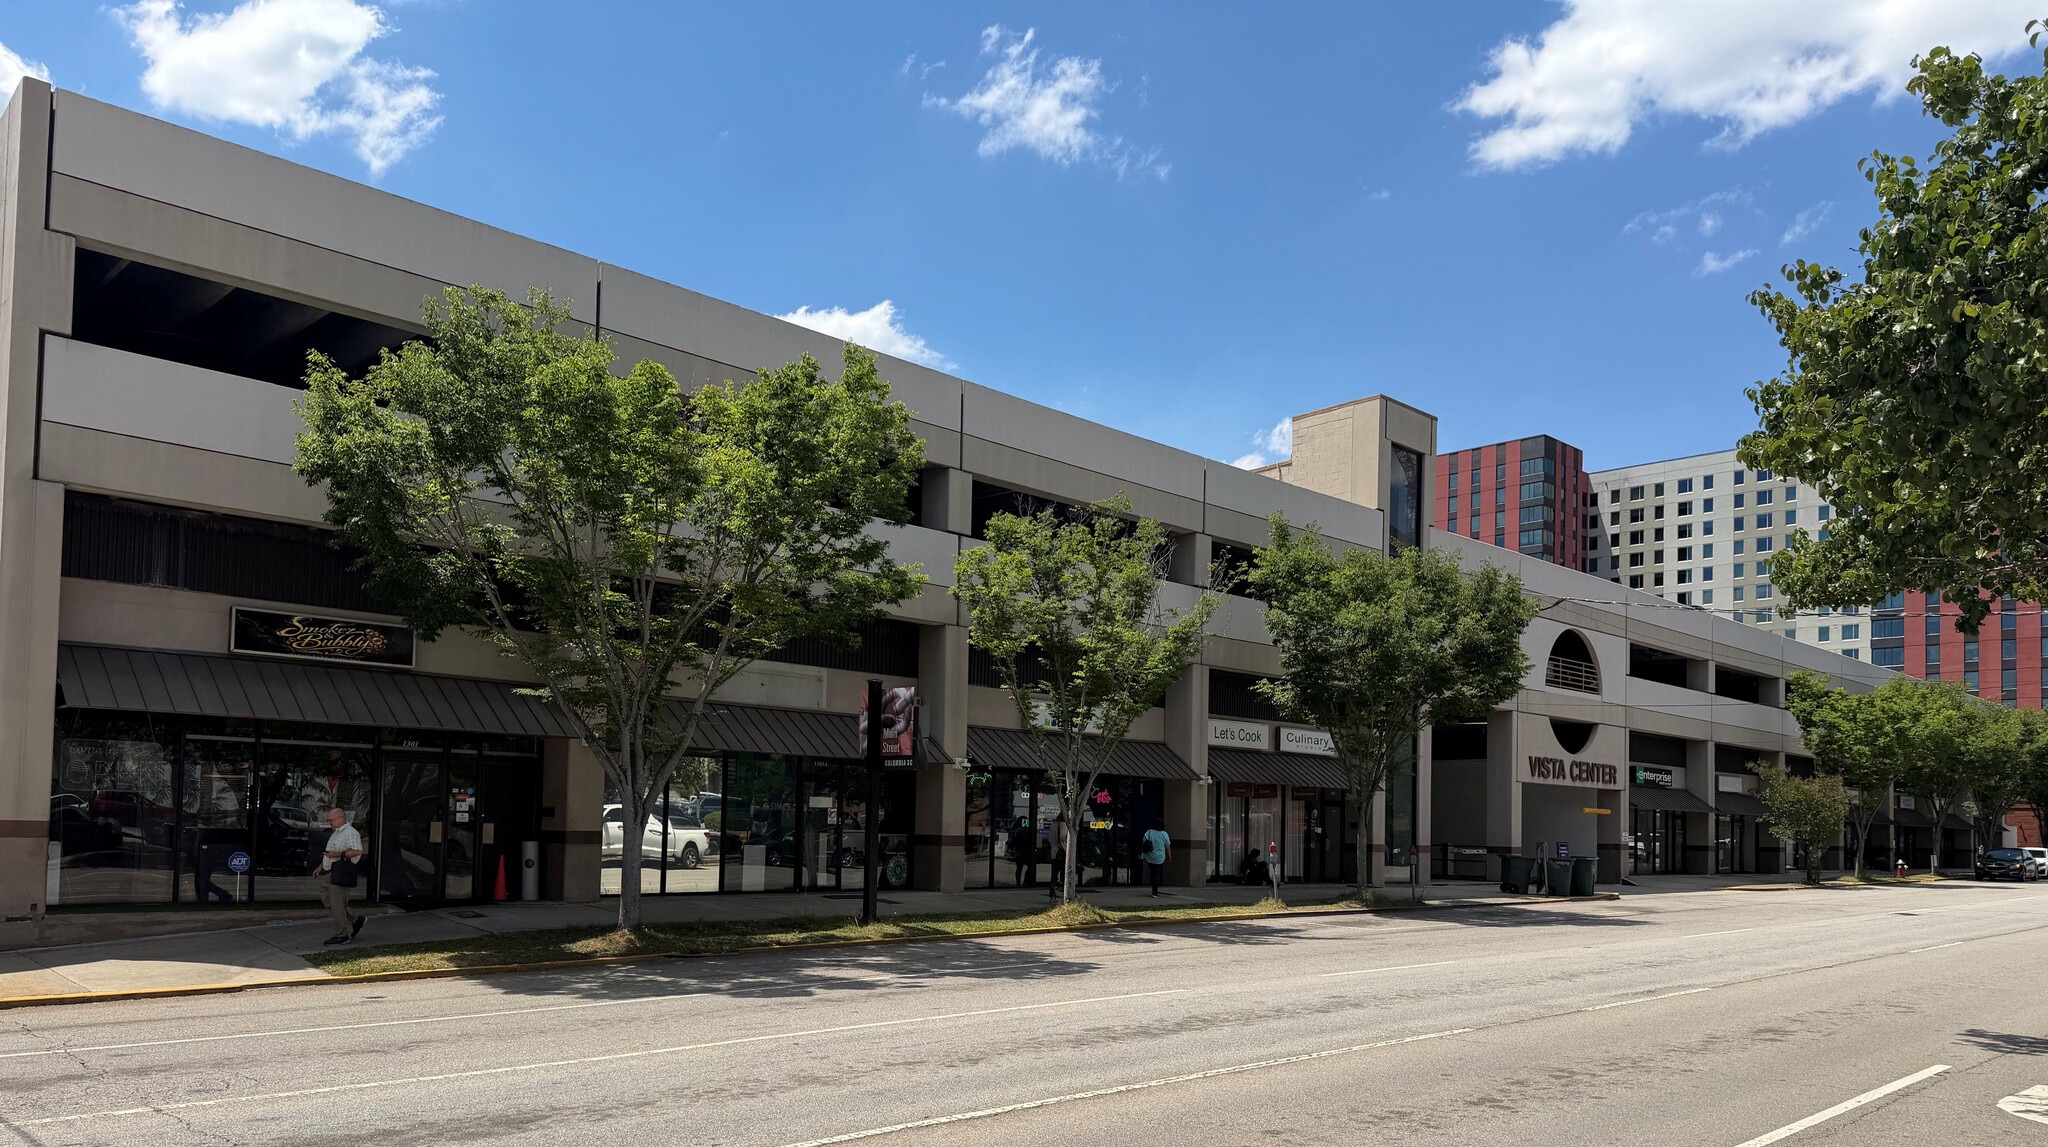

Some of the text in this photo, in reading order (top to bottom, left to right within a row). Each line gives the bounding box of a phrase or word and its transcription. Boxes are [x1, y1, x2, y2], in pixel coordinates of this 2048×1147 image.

[292, 632, 371, 656] Bubbly
[883, 728, 898, 739] Main
[1214, 726, 1262, 743] Let's Cook
[1286, 732, 1329, 748] Culinary
[403, 740, 419, 748] 1301
[883, 741, 901, 753] Street
[884, 759, 914, 767] COLUMBIA SC
[1529, 755, 1617, 785] VISTA CENTER
[1637, 770, 1672, 784] enterprise
[231, 858, 248, 866] ADT
